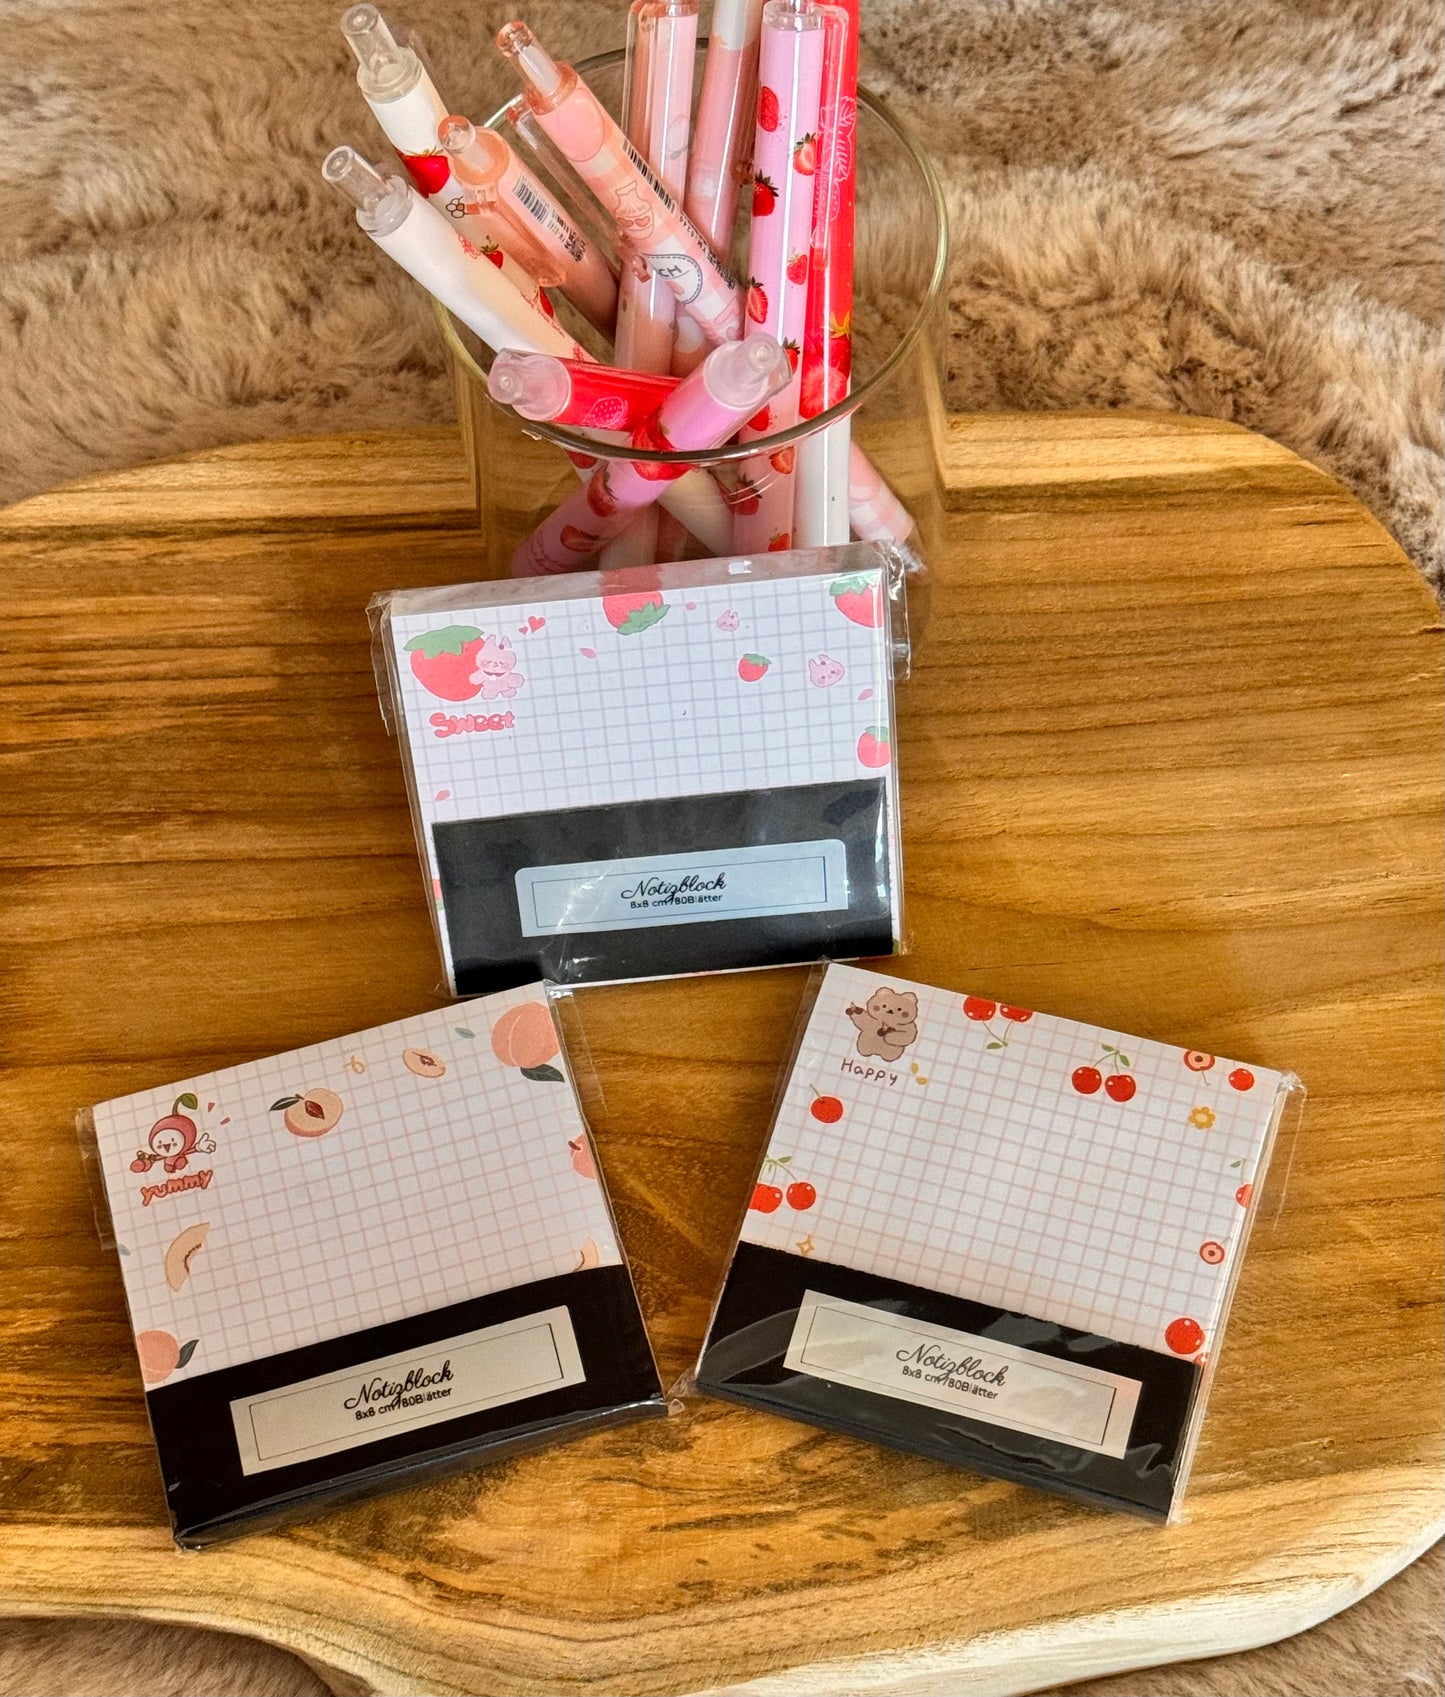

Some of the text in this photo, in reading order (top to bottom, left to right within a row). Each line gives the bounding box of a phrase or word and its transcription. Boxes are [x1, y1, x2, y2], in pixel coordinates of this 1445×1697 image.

[429, 710, 515, 738] Sweet
[621, 872, 726, 903] Notizblock
[630, 899, 649, 909] 8x8
[840, 1058, 898, 1086] Happy
[895, 1343, 1009, 1387] Notizblock
[902, 1365, 922, 1379] 8x8
[343, 1359, 454, 1410] Notizblock
[355, 1407, 376, 1420] 8x8
